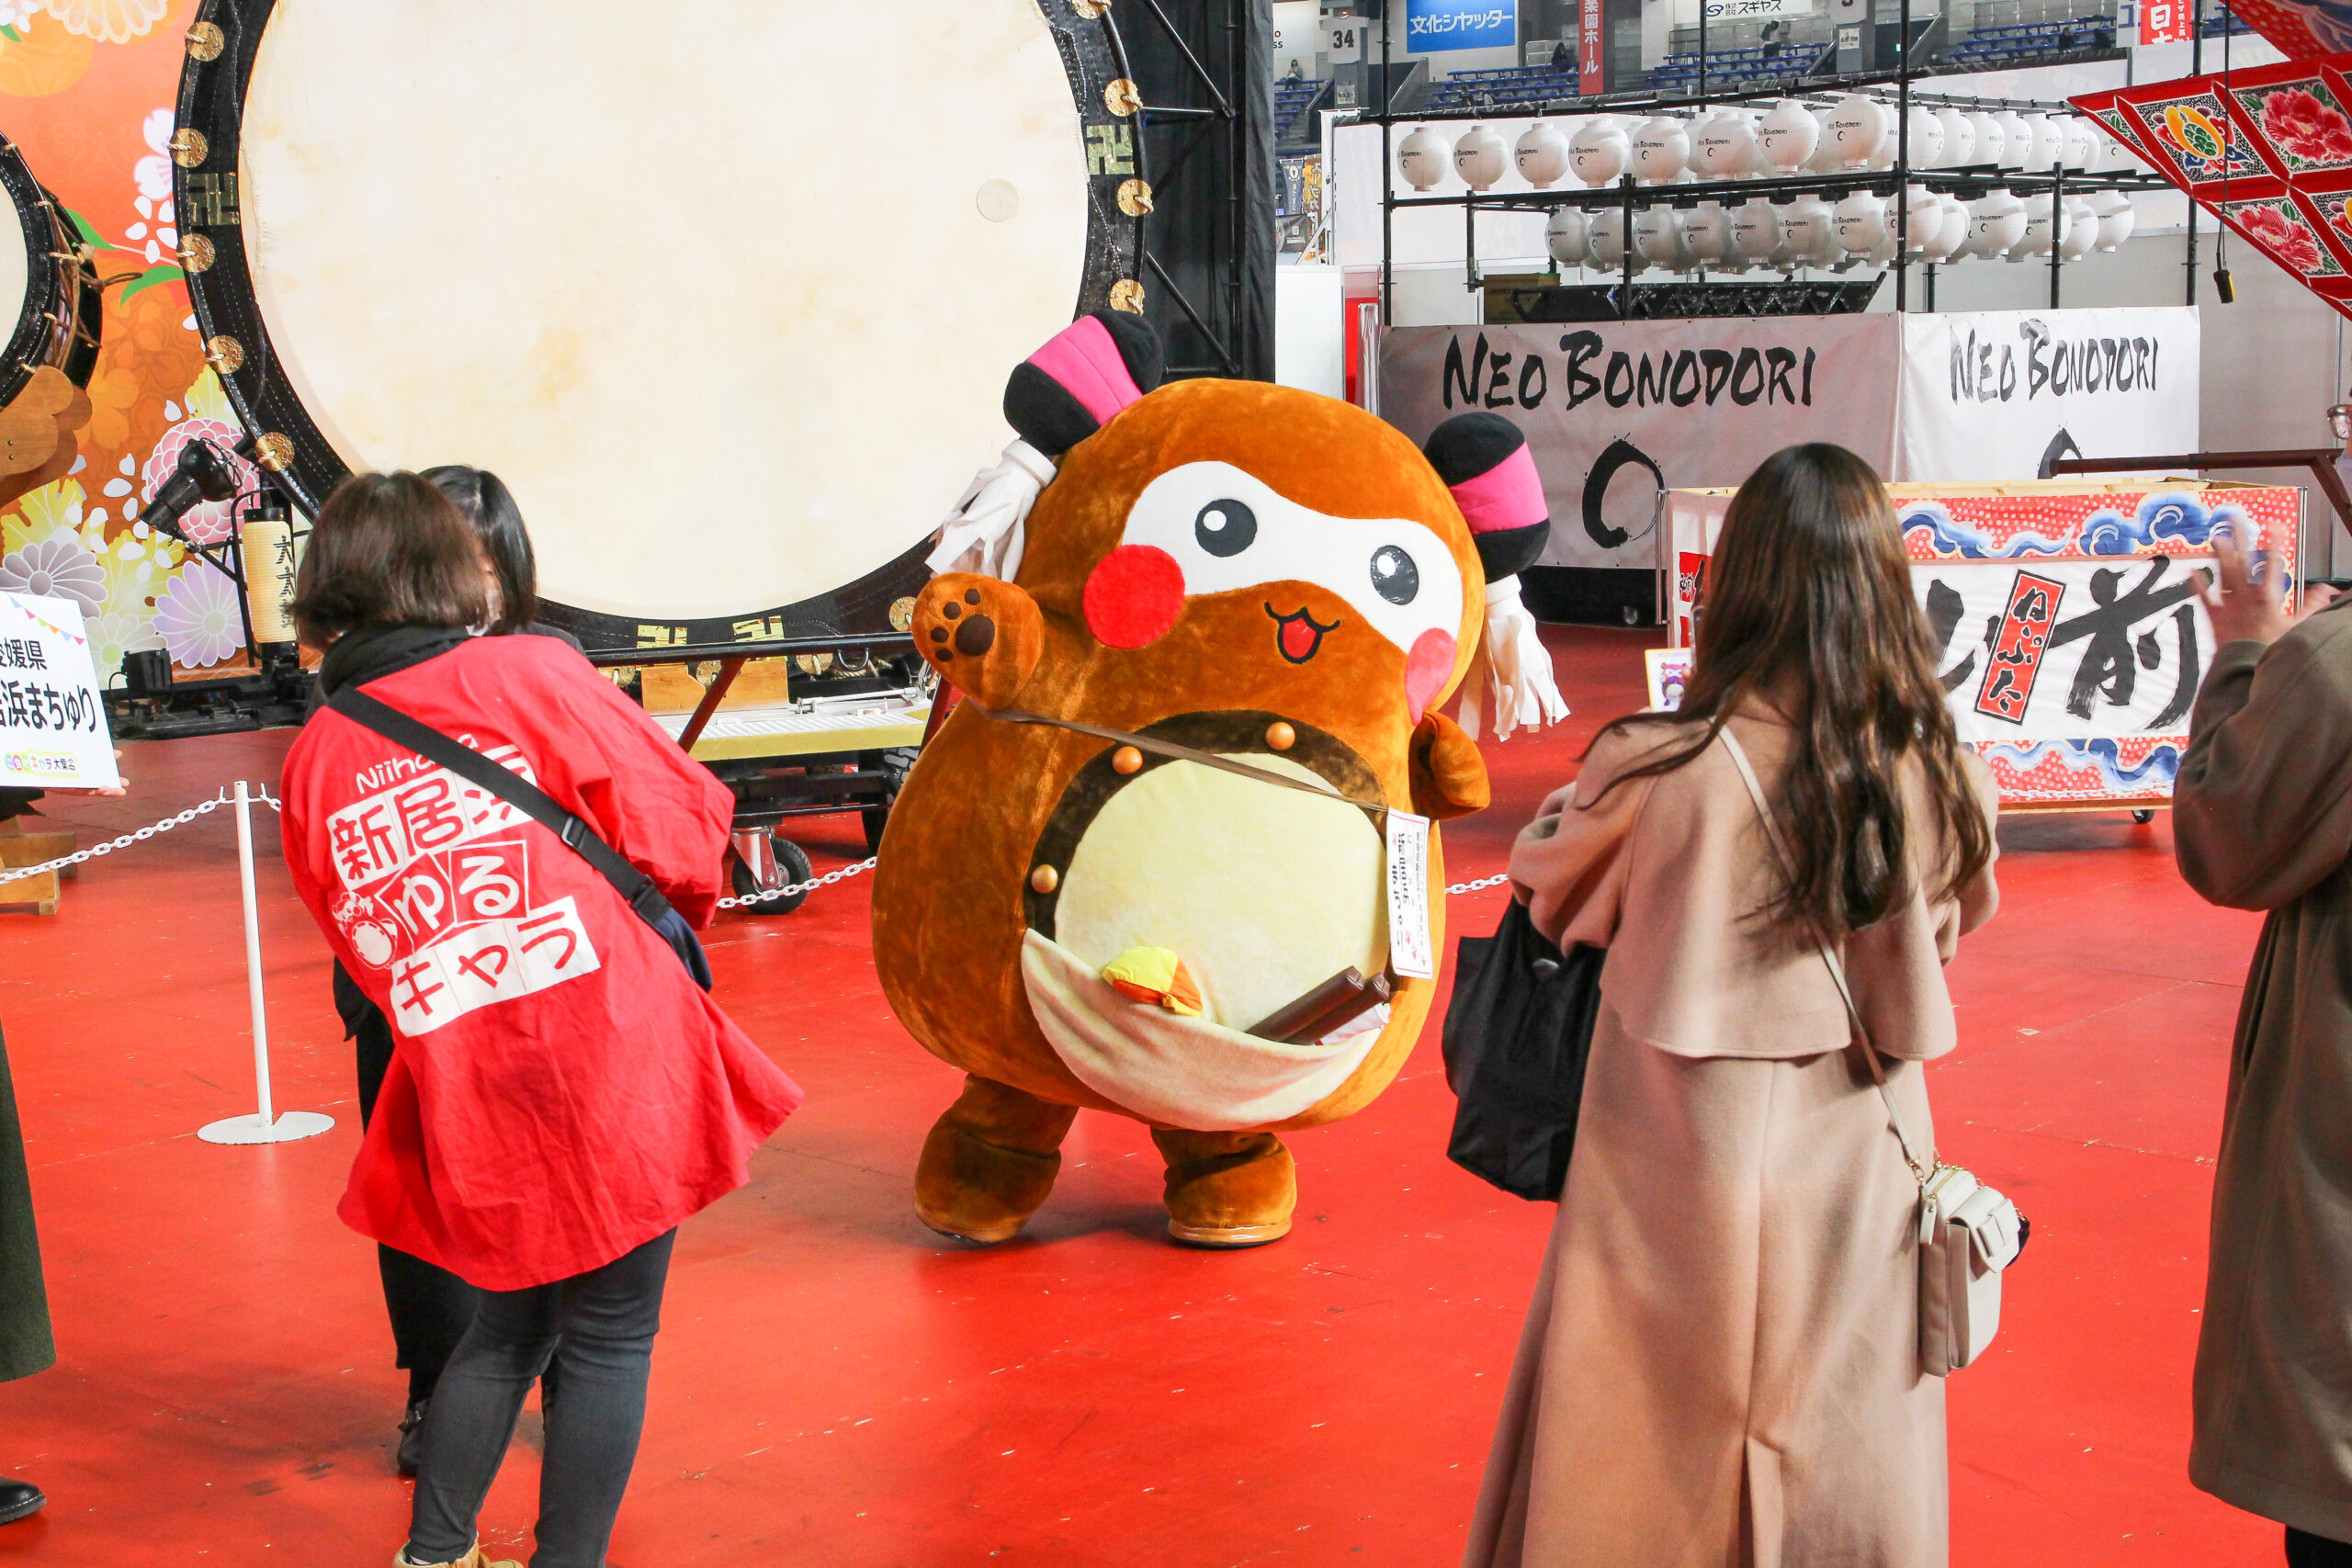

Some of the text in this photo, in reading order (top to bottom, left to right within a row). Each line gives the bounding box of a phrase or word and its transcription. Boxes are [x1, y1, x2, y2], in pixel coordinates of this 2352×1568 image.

[1333, 29, 1354, 49] 34
[1442, 330, 1816, 411] NEO BONODORI
[1949, 318, 2159, 405] NEO BONODORI
[356, 733, 480, 795] Niihaa
[394, 855, 520, 936] ゆる
[396, 910, 578, 1017] キャラ
